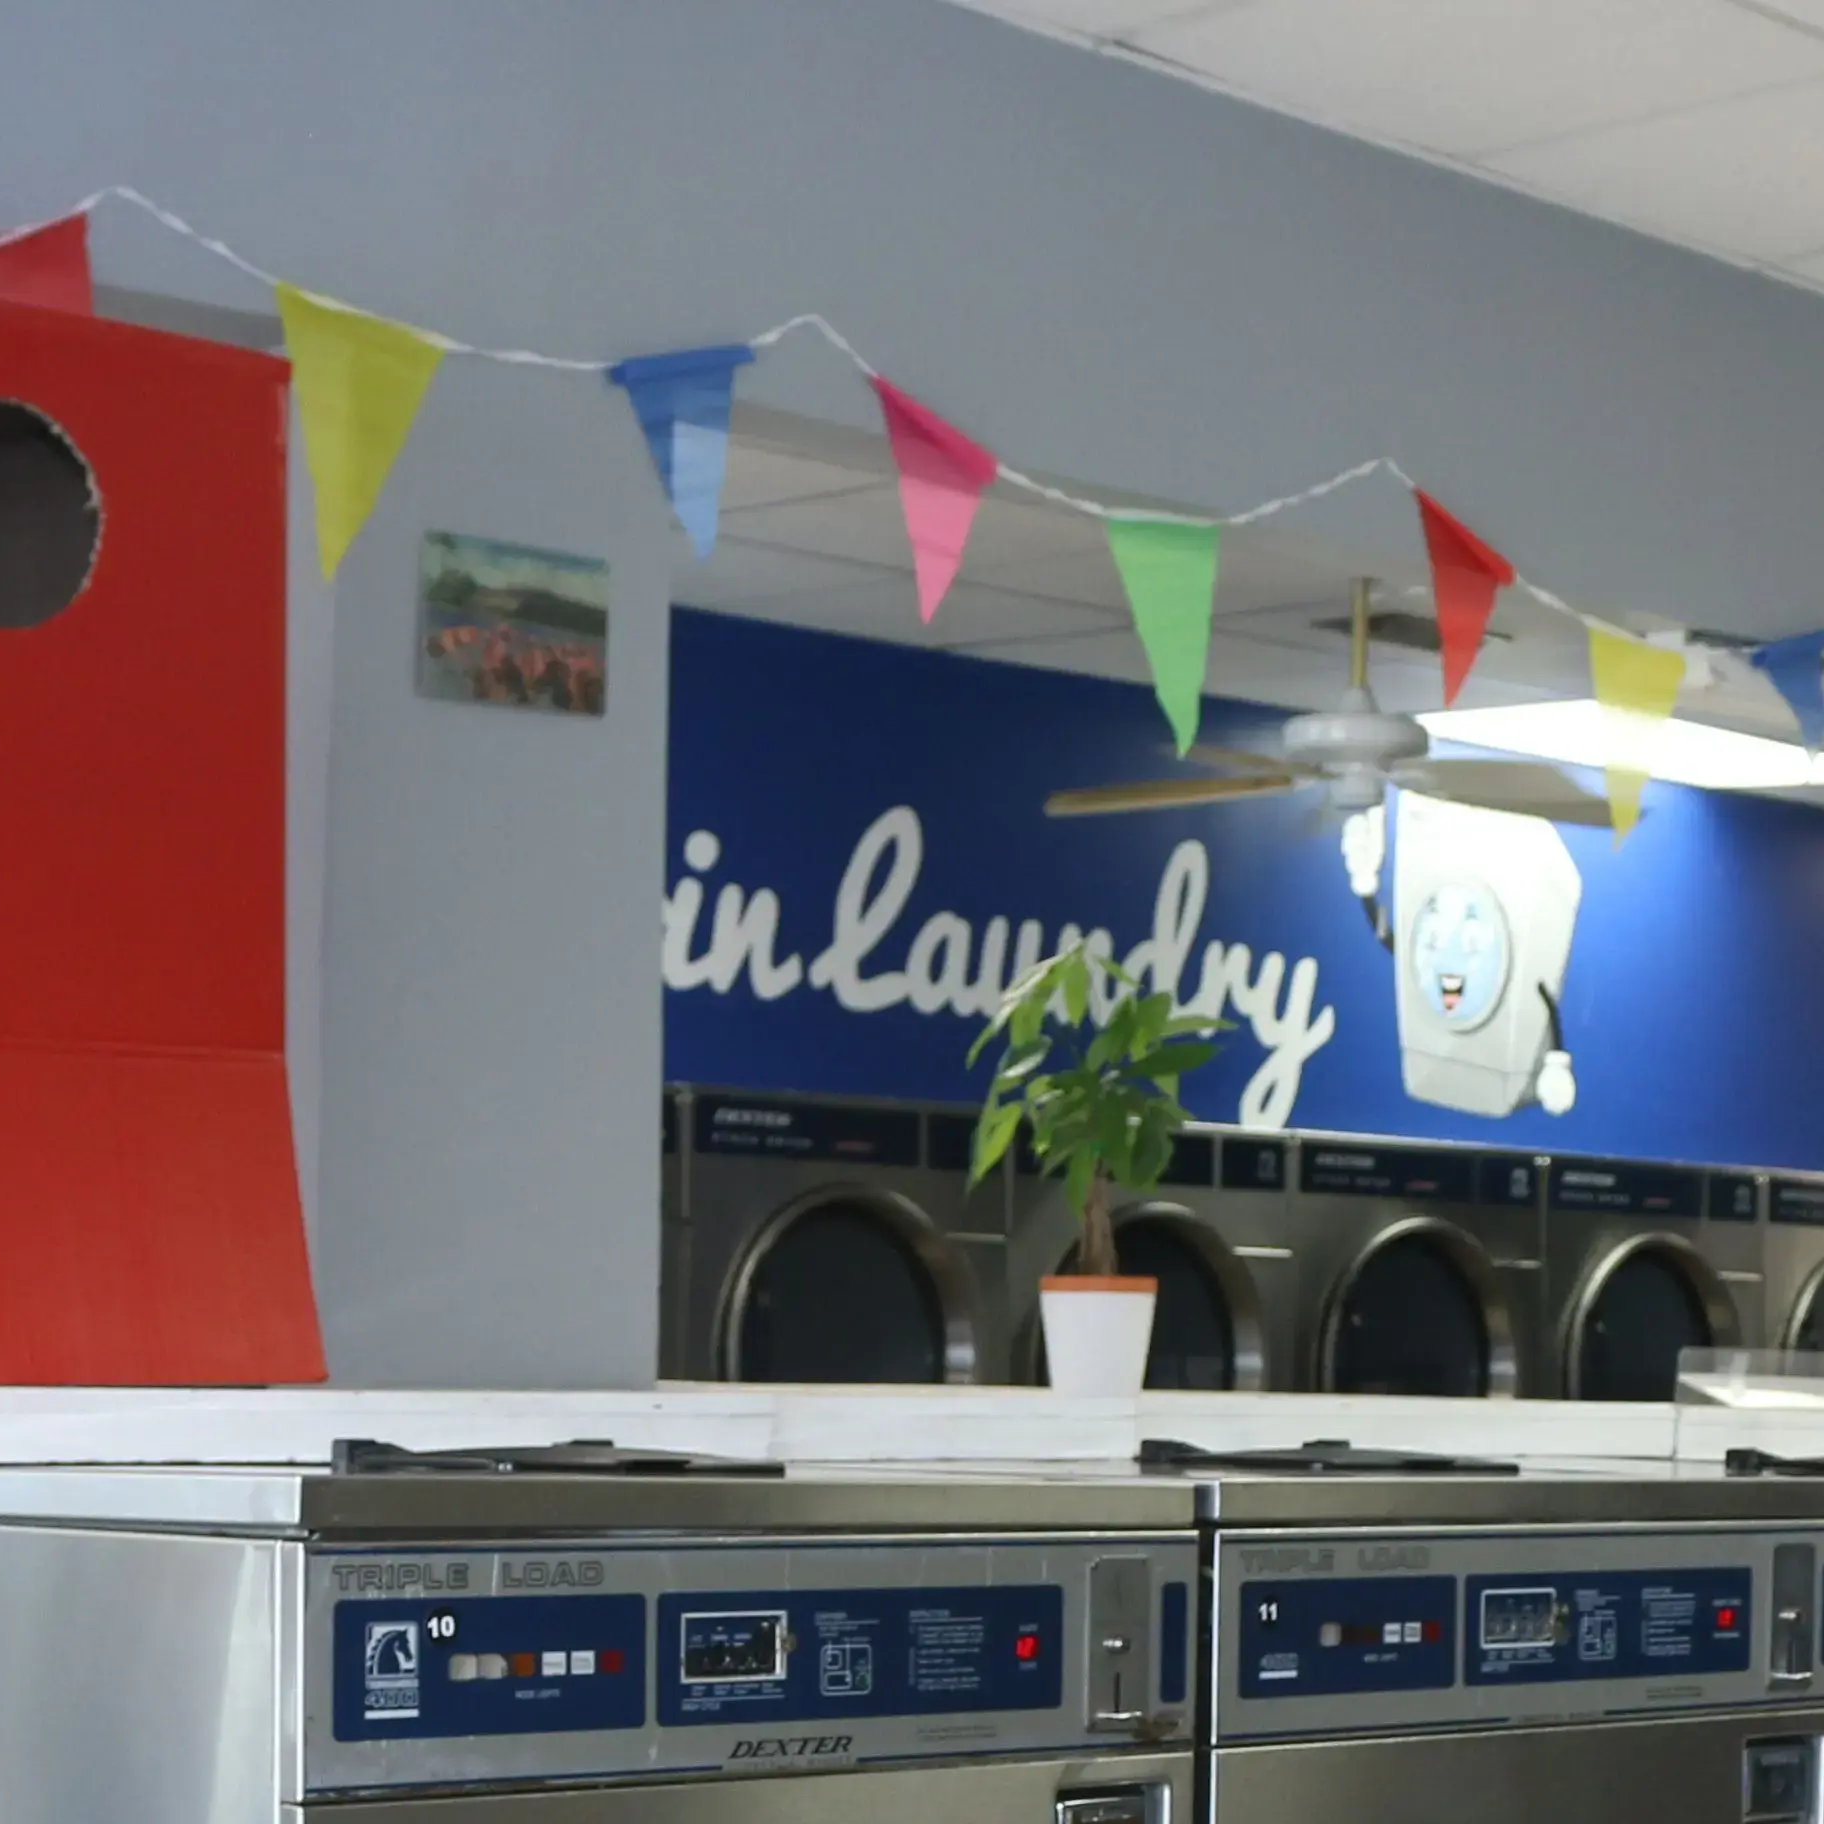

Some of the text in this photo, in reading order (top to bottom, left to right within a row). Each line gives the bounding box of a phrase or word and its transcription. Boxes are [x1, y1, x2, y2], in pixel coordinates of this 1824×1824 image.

[809, 806, 1334, 1129] laundry
[332, 1561, 605, 1591] TRIPLE LOAD
[1259, 1603, 1278, 1621] 11
[427, 1615, 456, 1638] 10
[728, 1735, 853, 1760] DEXTER
